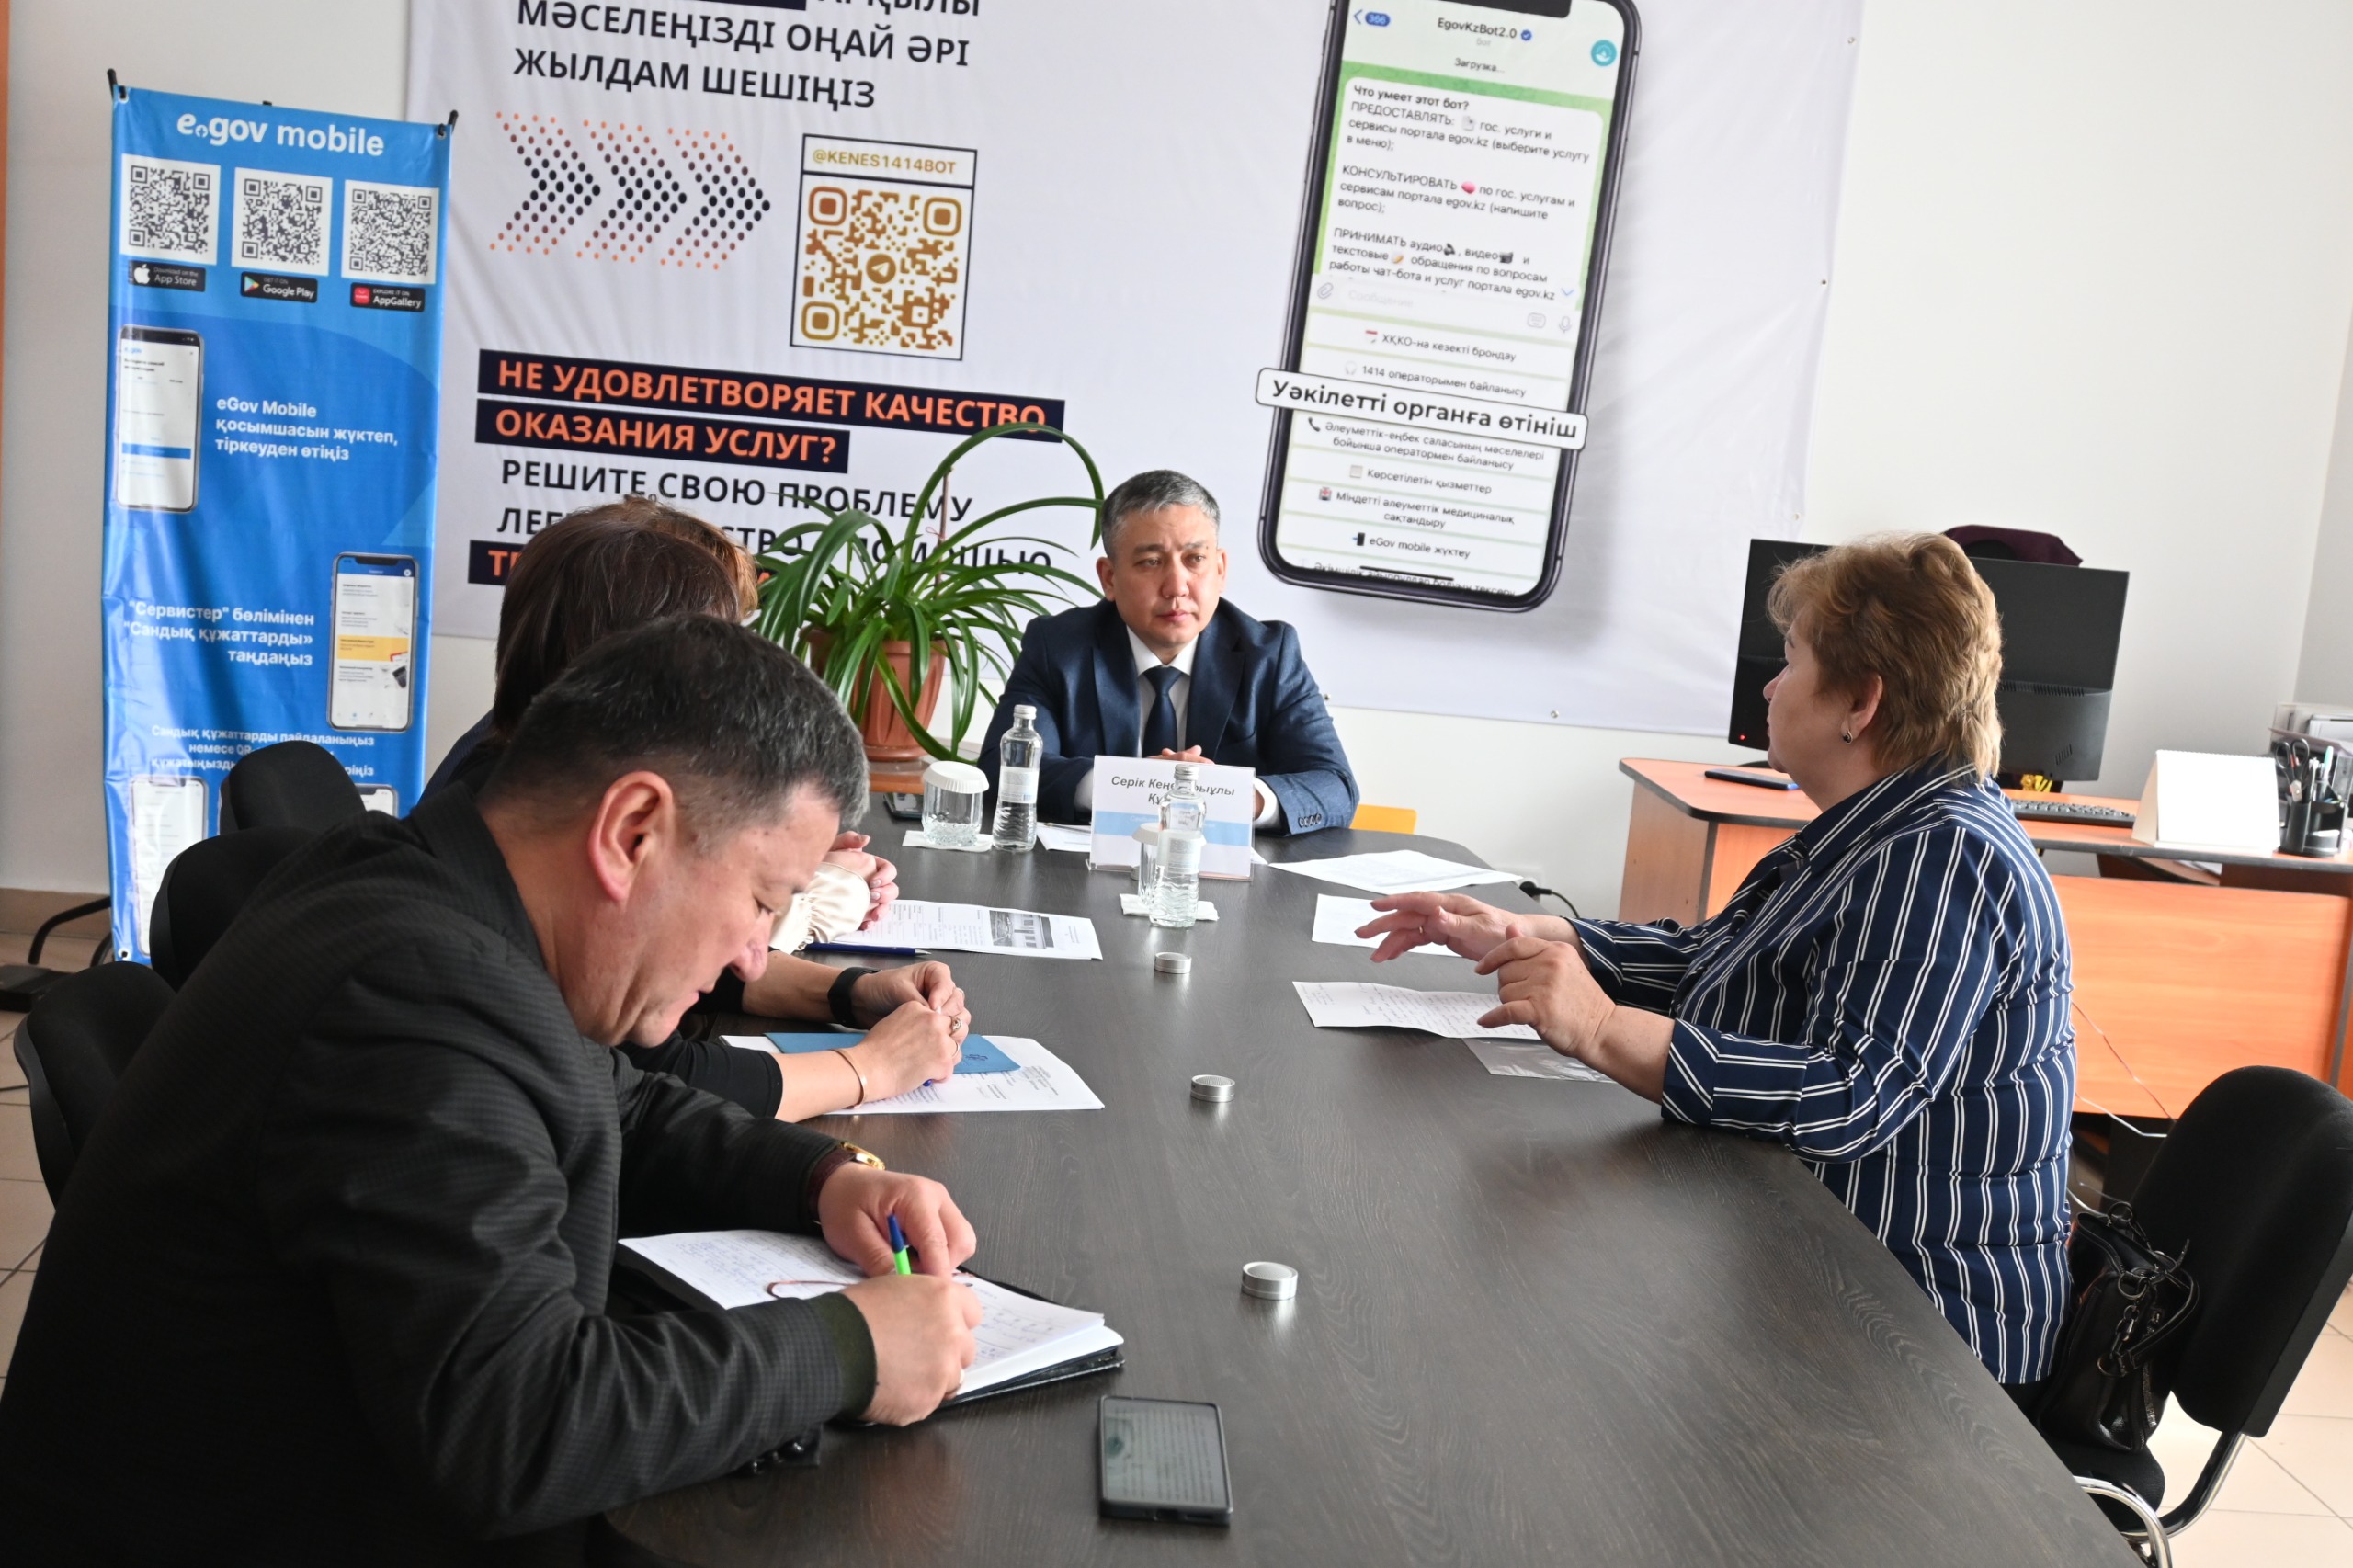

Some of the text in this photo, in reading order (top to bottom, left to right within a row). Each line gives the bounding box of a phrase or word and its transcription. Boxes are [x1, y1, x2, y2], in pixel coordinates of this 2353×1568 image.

[517, 0, 775, 53] МӘСЕЛЕҢІЗДІ
[787, 23, 894, 62] ОҢАЙ
[907, 36, 969, 66] ӘРІ
[1437, 17, 1518, 40] EgovKzBot2.0
[513, 48, 876, 111] ЖЫЛДАМ ШЕШІҢІЗ
[1353, 85, 1470, 110] Что умеет этот бот?
[1350, 101, 1552, 141] ПРЕДОСТАВЛЯТЬ: гос. услуги и
[277, 124, 384, 156] mobile
[1347, 136, 1394, 152] в меню);
[1348, 119, 1590, 163] сервисы портала egov.kz (выберите услугу
[813, 149, 957, 176] @KENES1414BOT
[1342, 165, 1575, 208] КОНСУЛЬТИРОВАТЬ по гос. услугам и
[1337, 198, 1386, 214] вопрос);
[1339, 182, 1549, 221] сервисам портала egov.kz (напишите
[1334, 227, 1407, 247] ПРИНИМАТЬ
[1332, 244, 1548, 283] текстовые обращения по вопросам
[154, 274, 197, 286] App Store
[263, 283, 315, 300] Google Play
[1329, 259, 1555, 301] работы чат-бота и услуг портала egov.kz
[372, 295, 422, 309] AppGallery
[1432, 341, 1470, 355] кезекті
[1472, 346, 1517, 362] брондау
[1362, 365, 1527, 398] 1414 операторымен байланысу
[216, 397, 316, 417] eGov Mobile
[498, 359, 1047, 435] НЕ УДОВЛЕТВОРЯЕТ КАЧЕСТВО
[1272, 379, 1577, 438] Уәкілетті органға өтініш
[215, 418, 399, 446] қосымшасын жүктеп,
[495, 408, 837, 464] ОКАЗАНИЯ УСЛУГ?
[1423, 436, 1482, 453] саласының
[215, 437, 350, 462] тіркеуден өтіңіз
[1332, 436, 1515, 471] бойынша оператормен байланысу
[501, 459, 647, 495] РЕШИТЕ
[657, 472, 766, 506] СВОЮ
[1367, 468, 1493, 494] Көрсетілетін қызметтер
[1336, 491, 1381, 506] Міндетті
[1442, 507, 1515, 525] медициналық
[1383, 512, 1446, 529] сақтандыру
[1369, 536, 1471, 560] eGov mobile жүктеу
[233, 605, 314, 626] бөлімінен
[199, 627, 313, 647] құжаттарды»
[228, 648, 313, 667] таңдаңыз
[188, 744, 234, 754] немесе
[201, 730, 278, 743] құжаттарды
[1111, 776, 1146, 789] Серік
